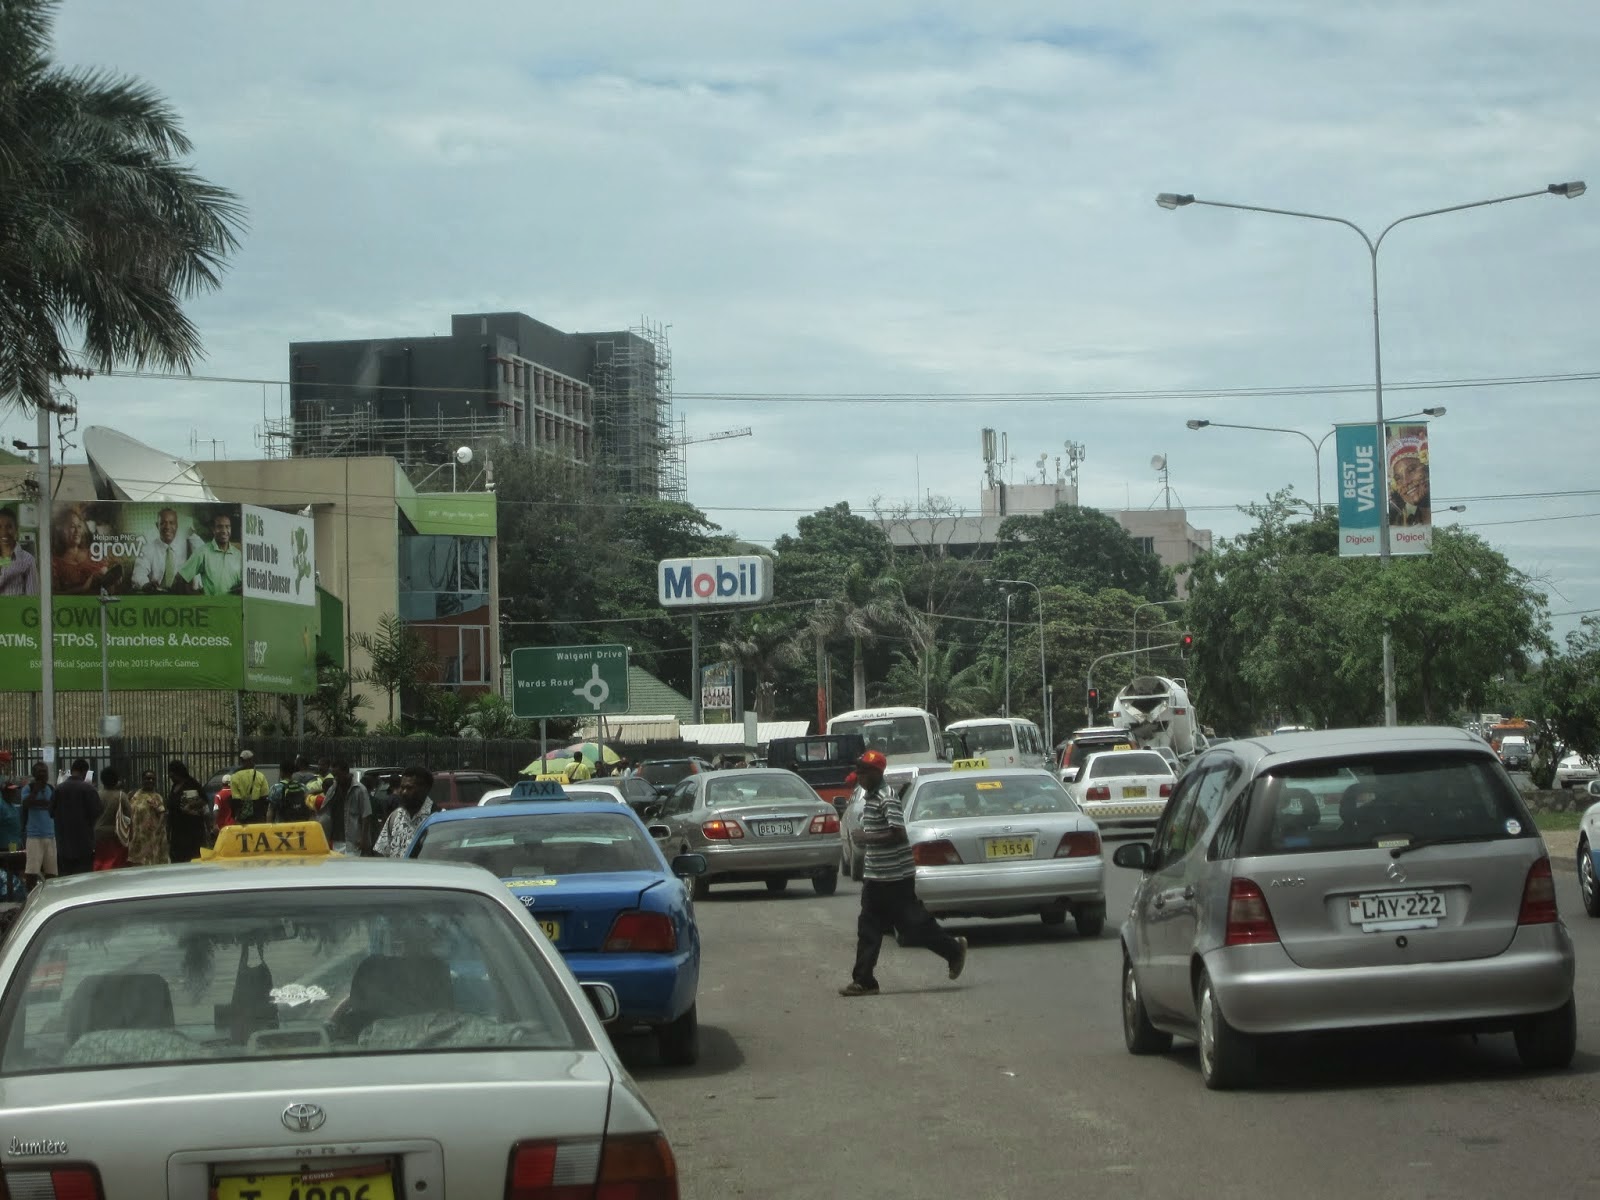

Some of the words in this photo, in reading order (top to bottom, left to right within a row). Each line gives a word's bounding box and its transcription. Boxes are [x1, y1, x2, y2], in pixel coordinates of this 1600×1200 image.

[1343, 461, 1356, 498] BEST
[1356, 445, 1375, 512] VALUE
[258, 515, 264, 537] is
[93, 534, 119, 542] Helping
[1345, 535, 1375, 545] Digicel
[1396, 533, 1425, 543] Digicel
[246, 542, 264, 562] proud
[264, 544, 271, 564] to
[271, 544, 279, 565] be
[246, 567, 268, 592] Official
[268, 570, 291, 594] Sponsor
[664, 564, 757, 599] Mobil
[22, 607, 137, 629] GOWING
[143, 607, 209, 628] MORE
[168, 633, 178, 646] &
[181, 633, 233, 647] Access.
[108, 660, 116, 668] of
[117, 660, 129, 668] the
[150, 659, 172, 668] Pacific
[556, 651, 592, 662] Waigani
[597, 650, 623, 659] Drive
[518, 679, 546, 688] Wards
[551, 678, 574, 687] Road
[957, 760, 985, 769] TAXI
[518, 782, 555, 797] TAXI
[236, 831, 307, 853] TAXI
[8, 1136, 69, 1155] Lumière
